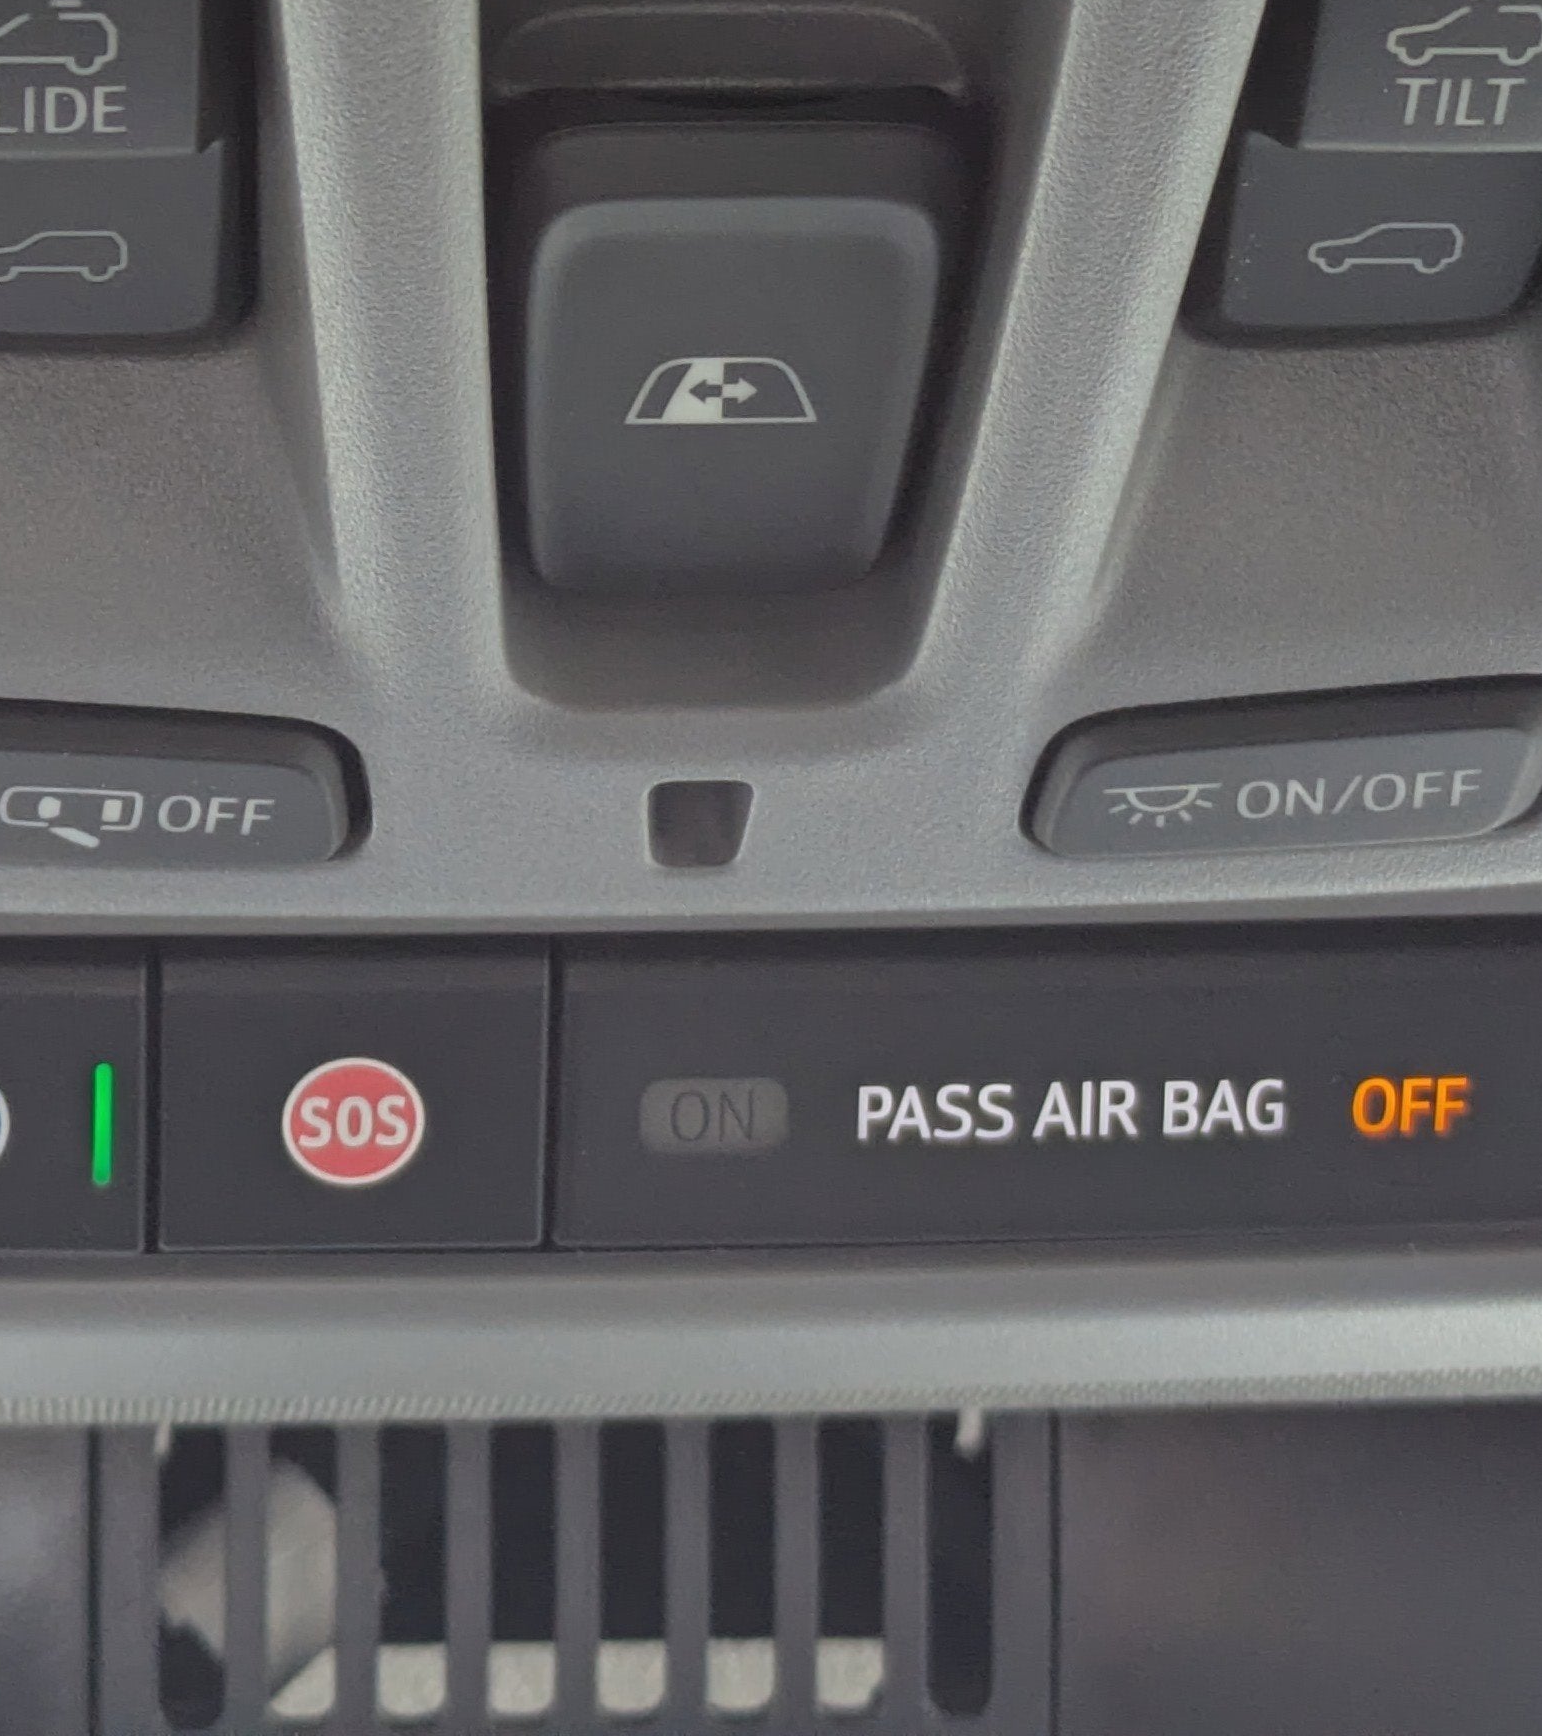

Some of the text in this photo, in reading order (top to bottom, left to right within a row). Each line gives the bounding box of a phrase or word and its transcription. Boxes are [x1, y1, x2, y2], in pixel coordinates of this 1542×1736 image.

[1395, 77, 1527, 126] TILT
[157, 794, 276, 836] OFF
[1236, 768, 1483, 820] ON/OFF
[297, 1094, 409, 1149] SOS
[669, 1090, 758, 1144] ON
[856, 1076, 1469, 1142] PASS AIR BAG OFF
